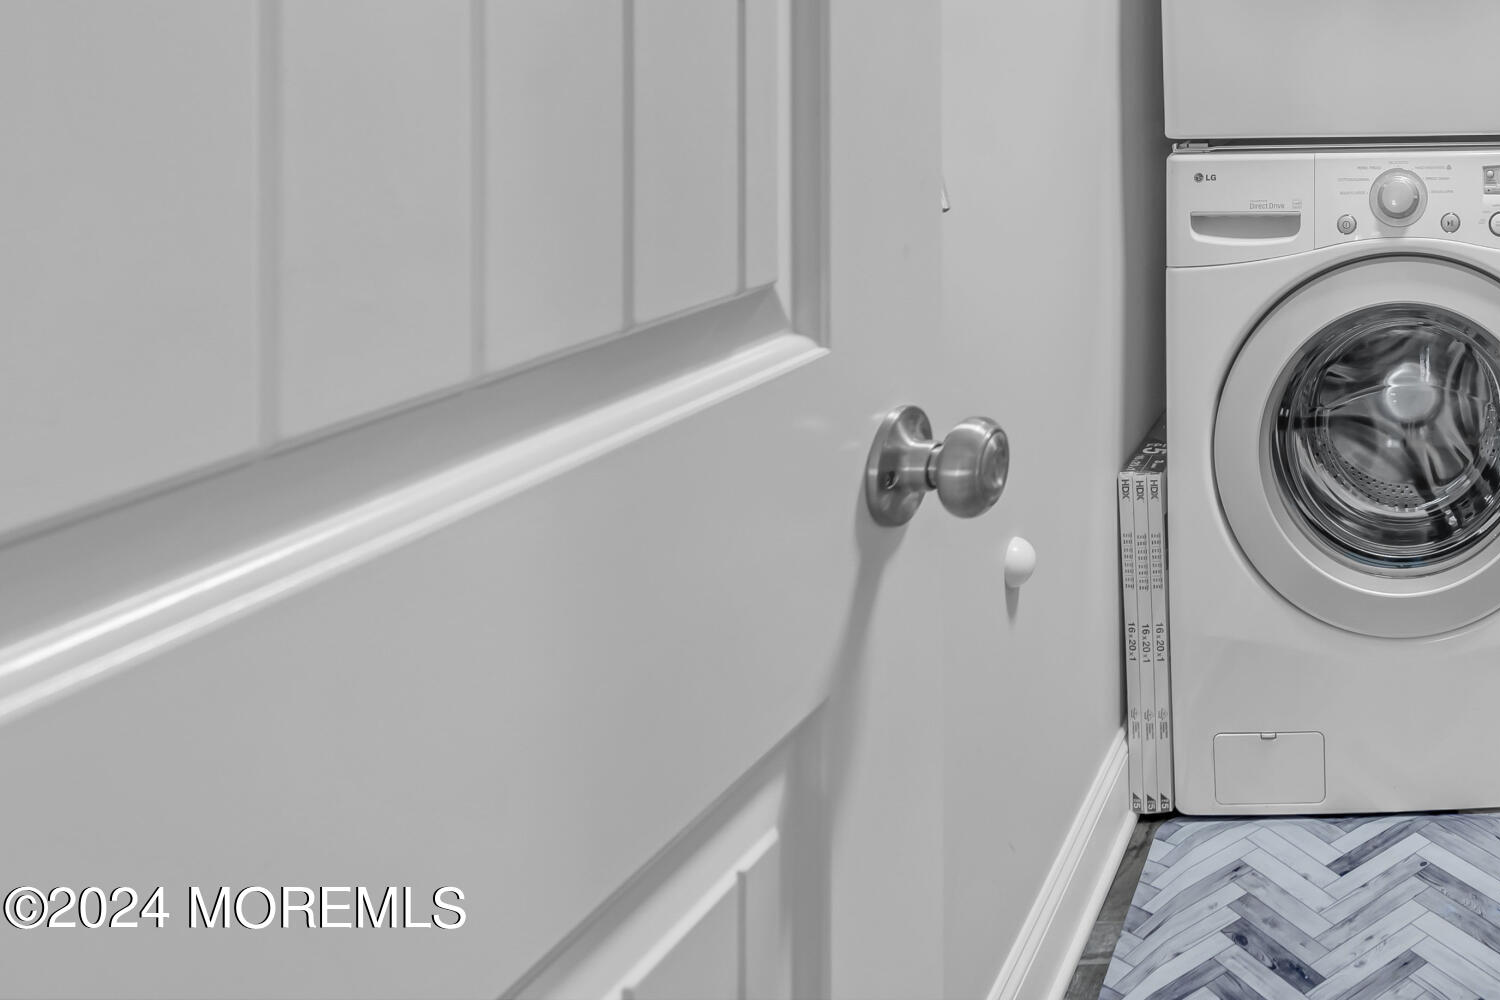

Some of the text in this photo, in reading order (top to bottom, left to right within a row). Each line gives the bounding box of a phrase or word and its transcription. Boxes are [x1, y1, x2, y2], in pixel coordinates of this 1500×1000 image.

[1205, 174, 1217, 182] LG
[1121, 479, 1130, 500] HDX
[1135, 480, 1144, 501] HDX
[1149, 479, 1159, 500] HDX
